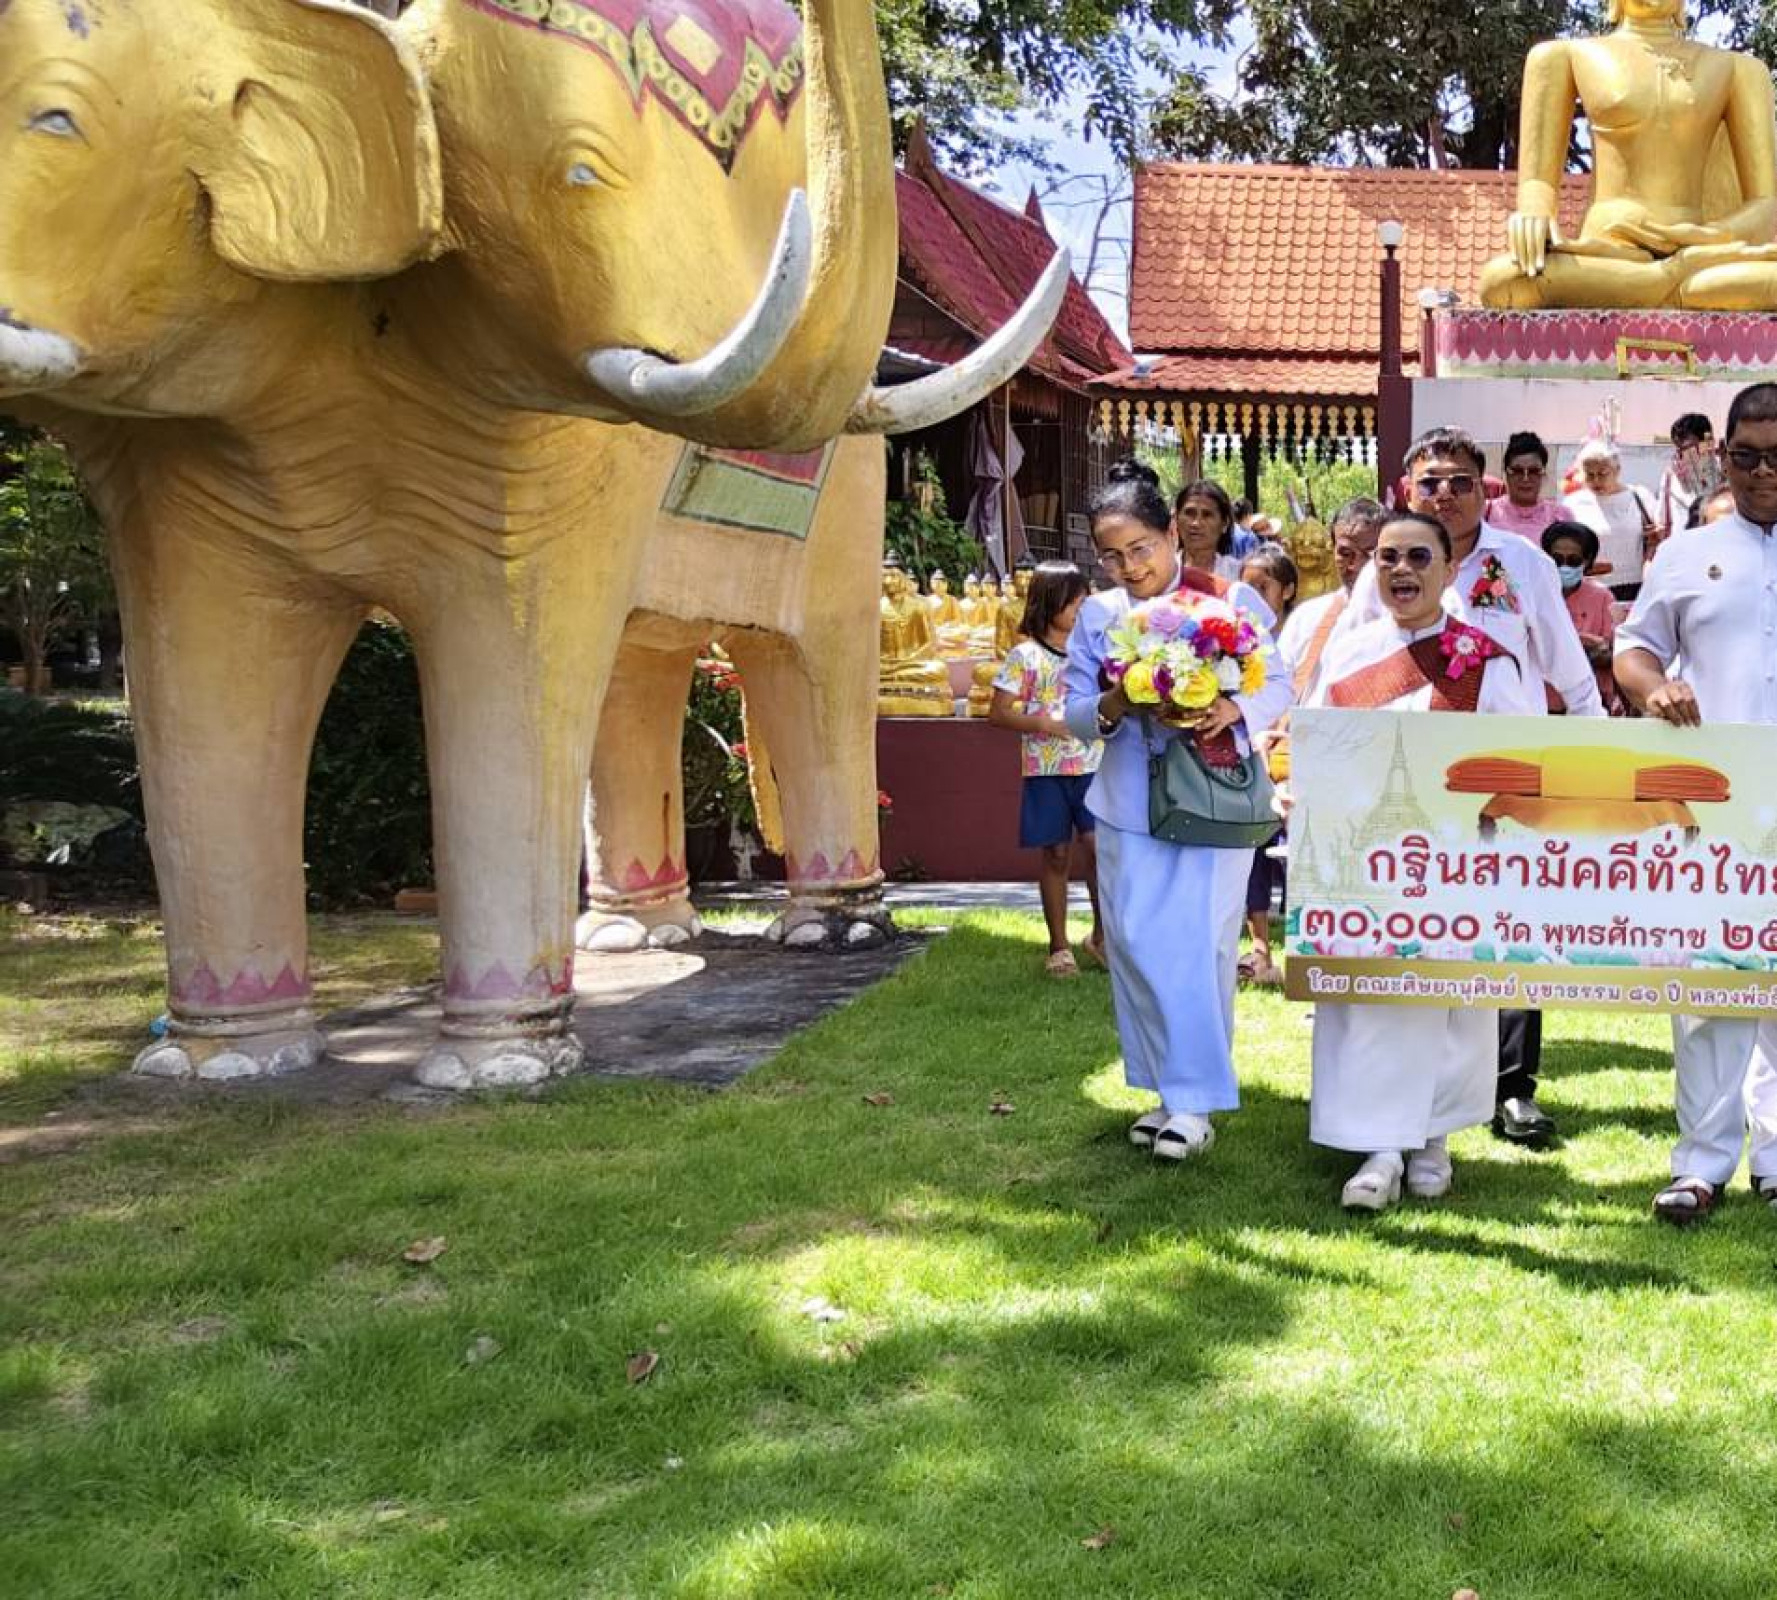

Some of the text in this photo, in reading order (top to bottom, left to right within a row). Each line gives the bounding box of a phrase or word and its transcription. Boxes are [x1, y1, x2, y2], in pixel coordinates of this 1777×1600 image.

[1305, 908, 1481, 945] ๓๐,๐๐๐
[1493, 910, 1532, 943] วัด
[1541, 914, 1708, 955] พุทธศักราช
[1307, 967, 1350, 993] โดย
[1524, 981, 1621, 1003] บูชาธรรม
[1665, 978, 1683, 1004] ปี
